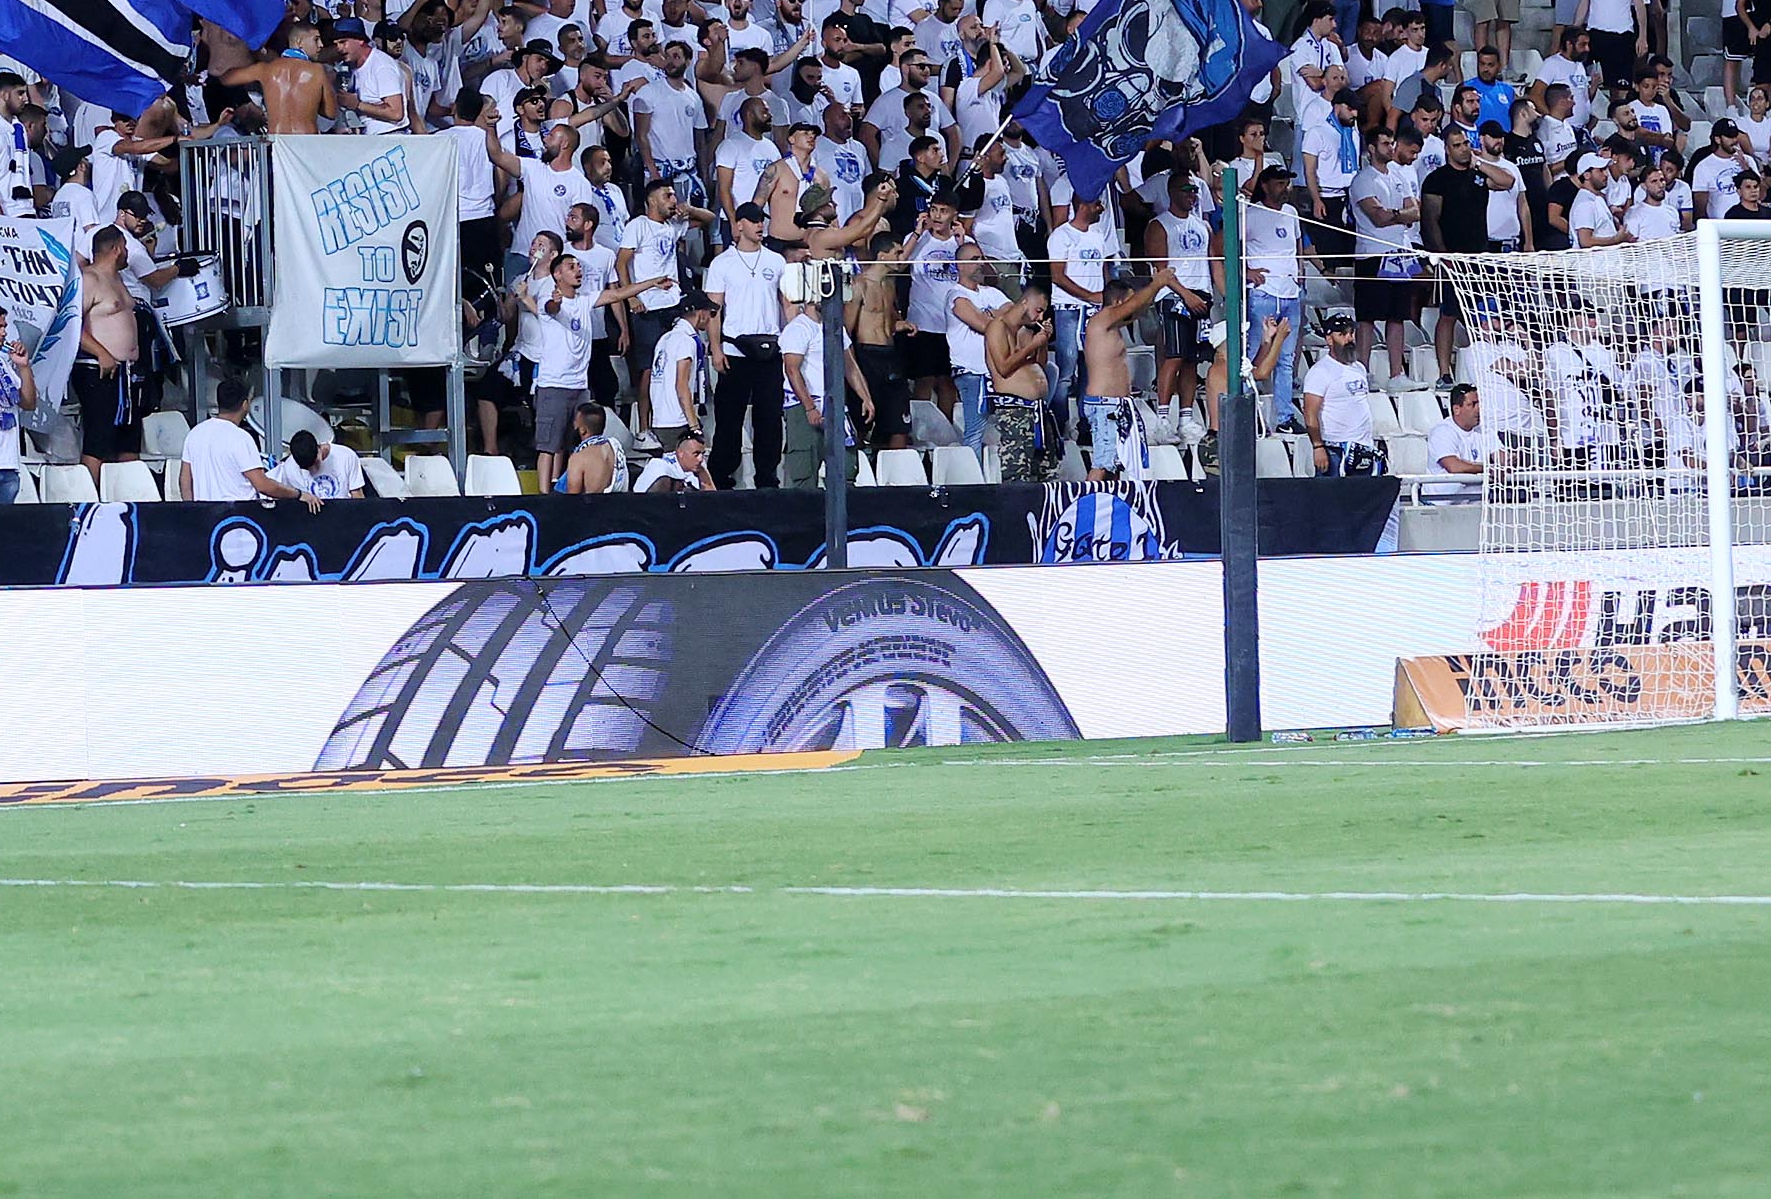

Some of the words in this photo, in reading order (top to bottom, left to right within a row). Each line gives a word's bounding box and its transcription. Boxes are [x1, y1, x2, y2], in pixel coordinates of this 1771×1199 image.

[310, 144, 421, 256] RESIST
[357, 246, 395, 282] TO
[323, 287, 423, 348] EXIST
